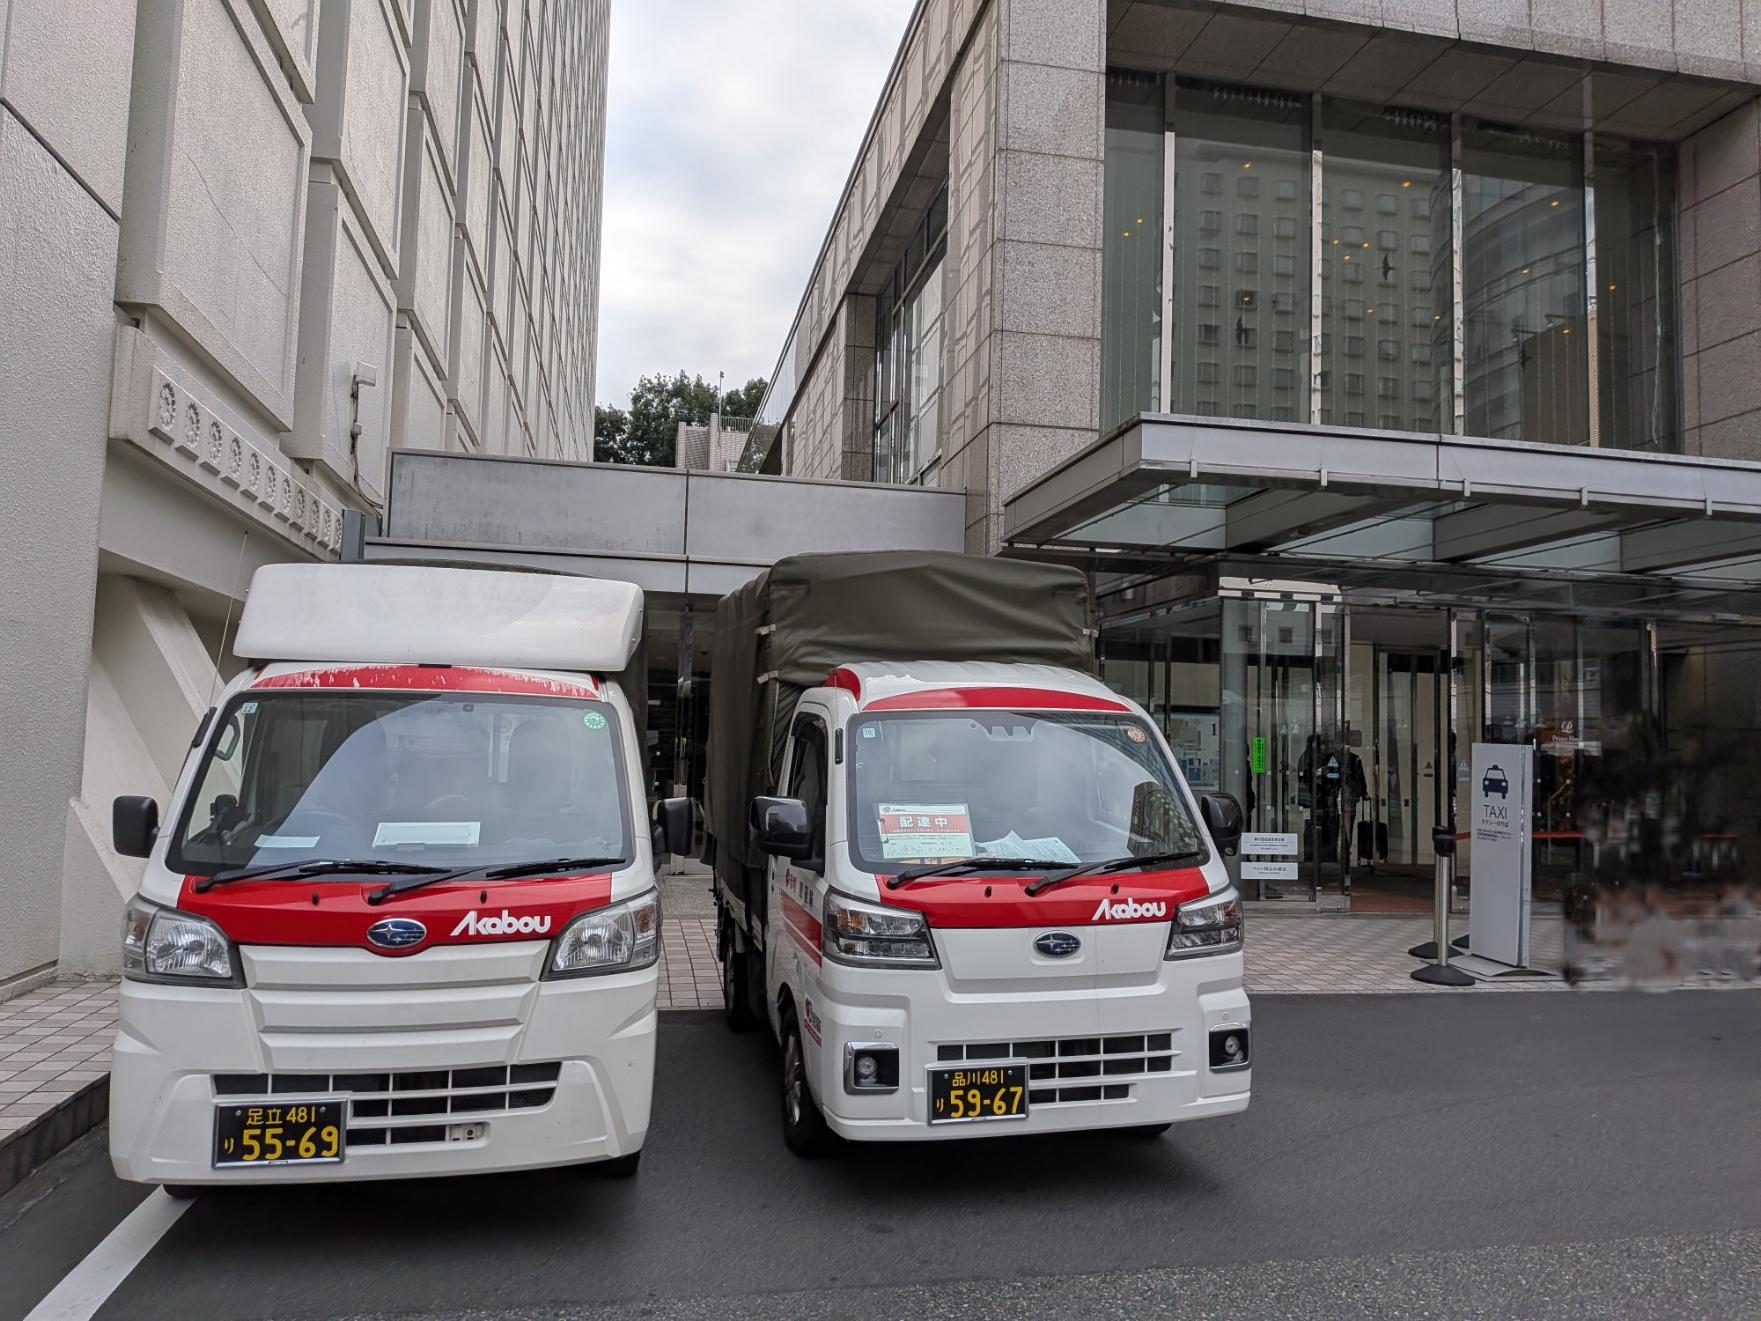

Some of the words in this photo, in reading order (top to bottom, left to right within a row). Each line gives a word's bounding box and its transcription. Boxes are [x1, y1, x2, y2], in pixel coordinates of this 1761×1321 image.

[899, 816, 948, 829] 配達中
[1483, 804, 1508, 820] TAXI
[1091, 897, 1167, 921] Akabou
[449, 909, 552, 937] Akabou
[952, 1070, 980, 1086] 品川
[982, 1069, 1004, 1085] 481
[950, 1086, 1023, 1118] 59-67
[246, 1107, 283, 1125] 足立
[286, 1105, 316, 1123] 481
[242, 1125, 339, 1161] 55-69
